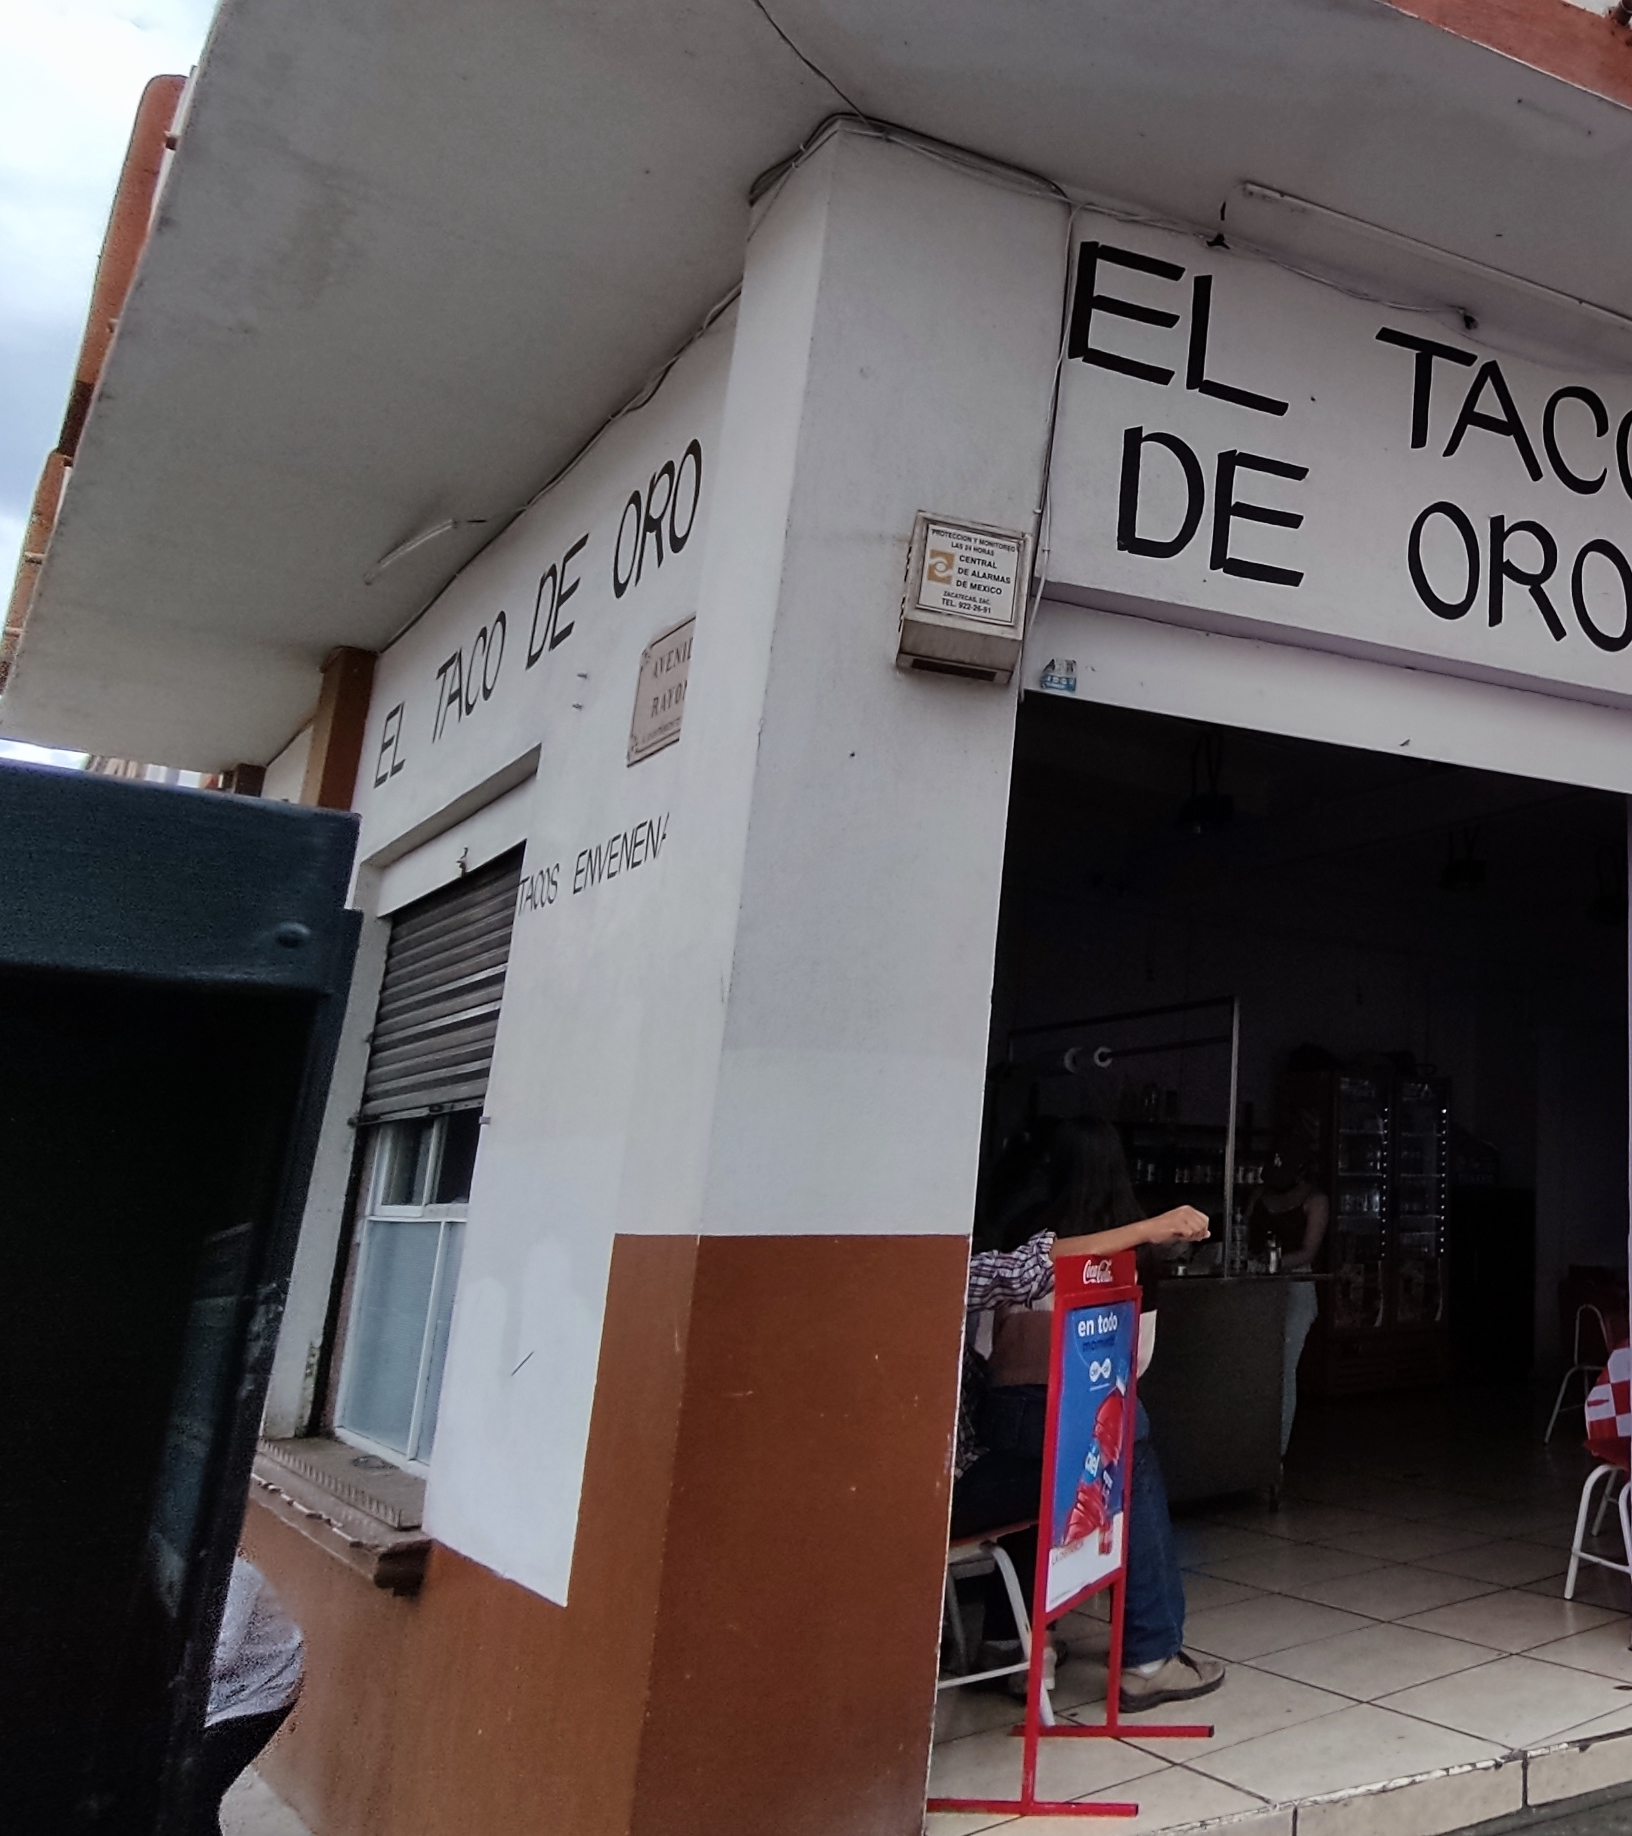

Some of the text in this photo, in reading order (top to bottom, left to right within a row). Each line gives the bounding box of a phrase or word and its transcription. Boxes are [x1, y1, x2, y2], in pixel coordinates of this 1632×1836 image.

[1068, 241, 1288, 415] EL
[1118, 426, 1309, 587] DE
[951, 541, 963, 550] LAS
[973, 546, 995, 556] HORAS
[959, 555, 998, 569] CENTRAL
[957, 567, 1011, 584] DE ALARMAS
[956, 579, 1003, 595] DE MEXICO
[374, 438, 702, 789] EL TACO DE ORO
[942, 598, 957, 608] TEL.
[518, 862, 560, 916] TACOS
[1078, 1312, 1118, 1337] en todo
